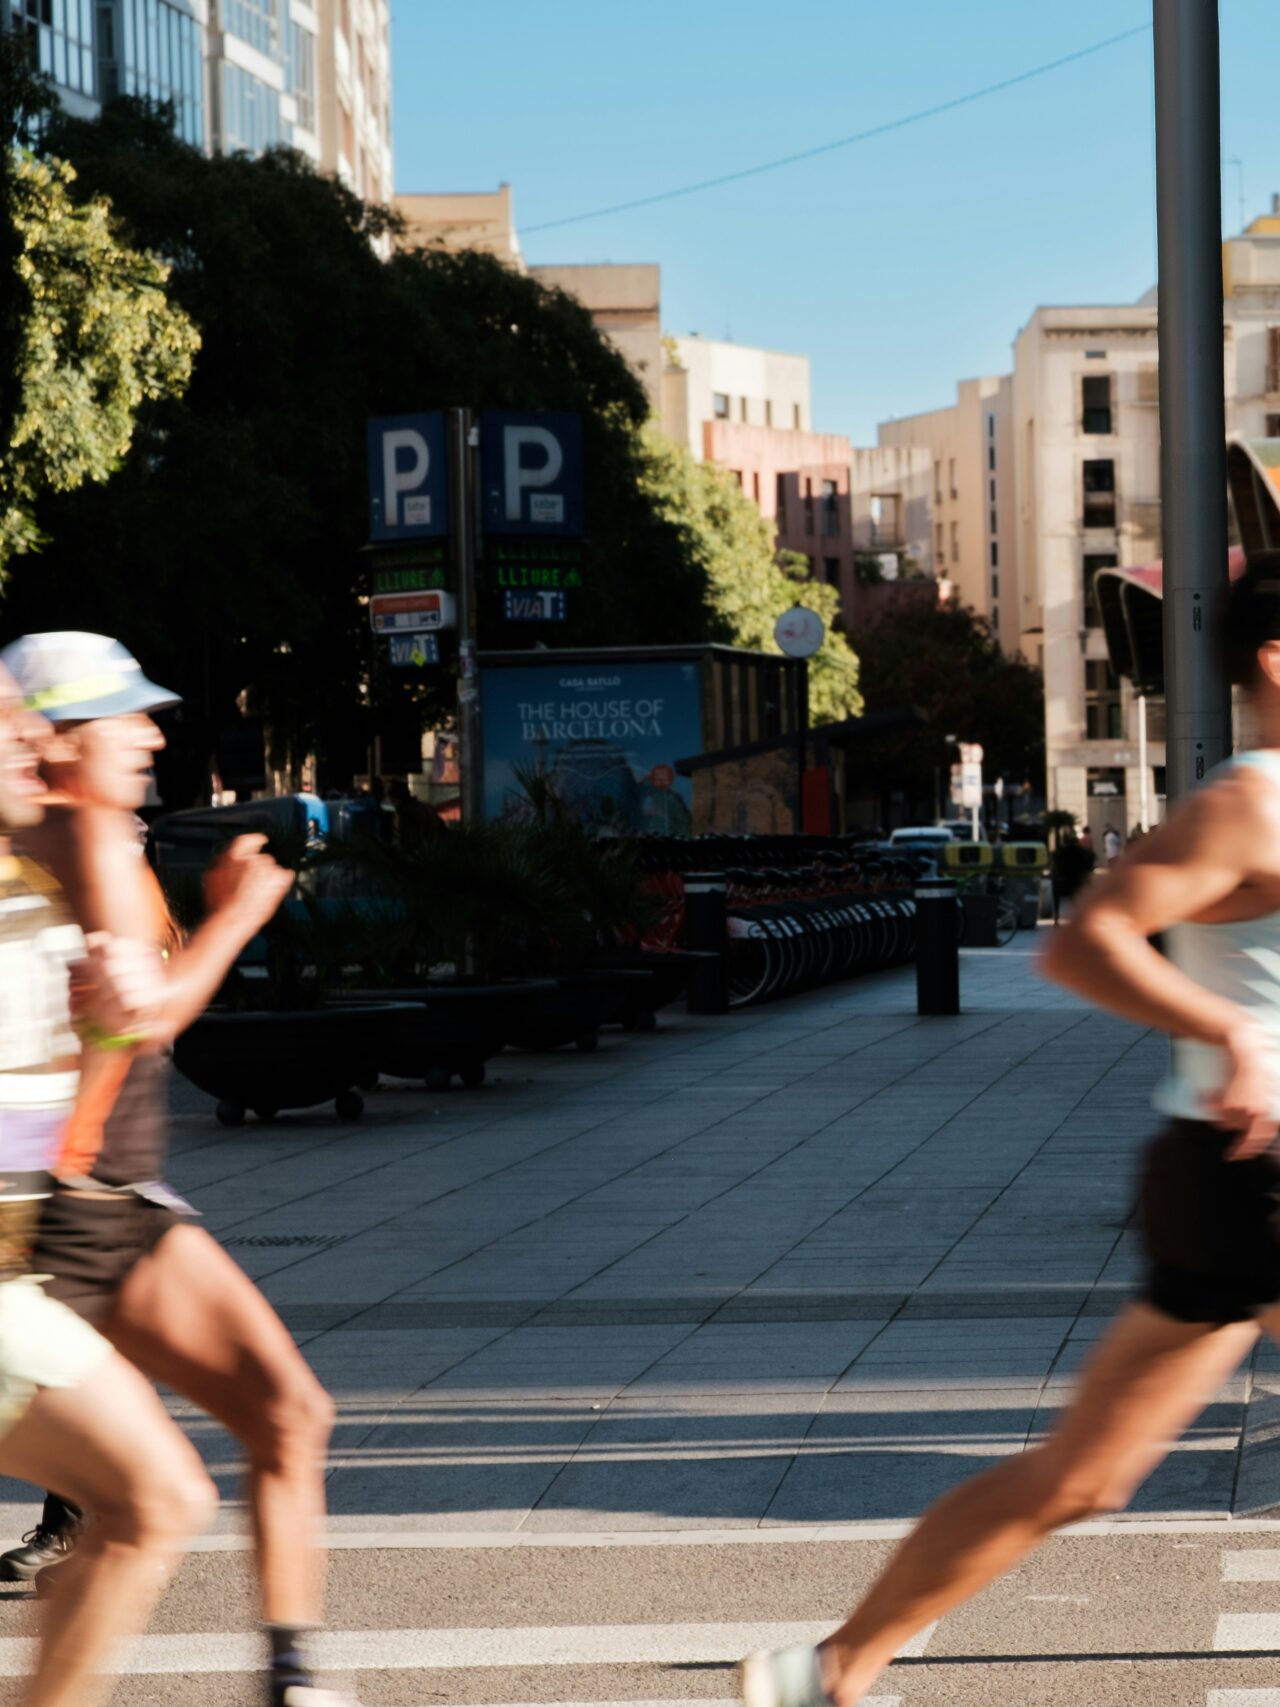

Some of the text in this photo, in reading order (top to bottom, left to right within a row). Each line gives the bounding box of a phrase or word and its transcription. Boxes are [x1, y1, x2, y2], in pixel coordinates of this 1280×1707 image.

[382, 428, 430, 527] P
[503, 424, 564, 521] P
[497, 567, 561, 587] LLIURE
[559, 677, 584, 688] CASA
[517, 698, 665, 720] THE HOUSE OF
[522, 718, 663, 741] BARCELONA
